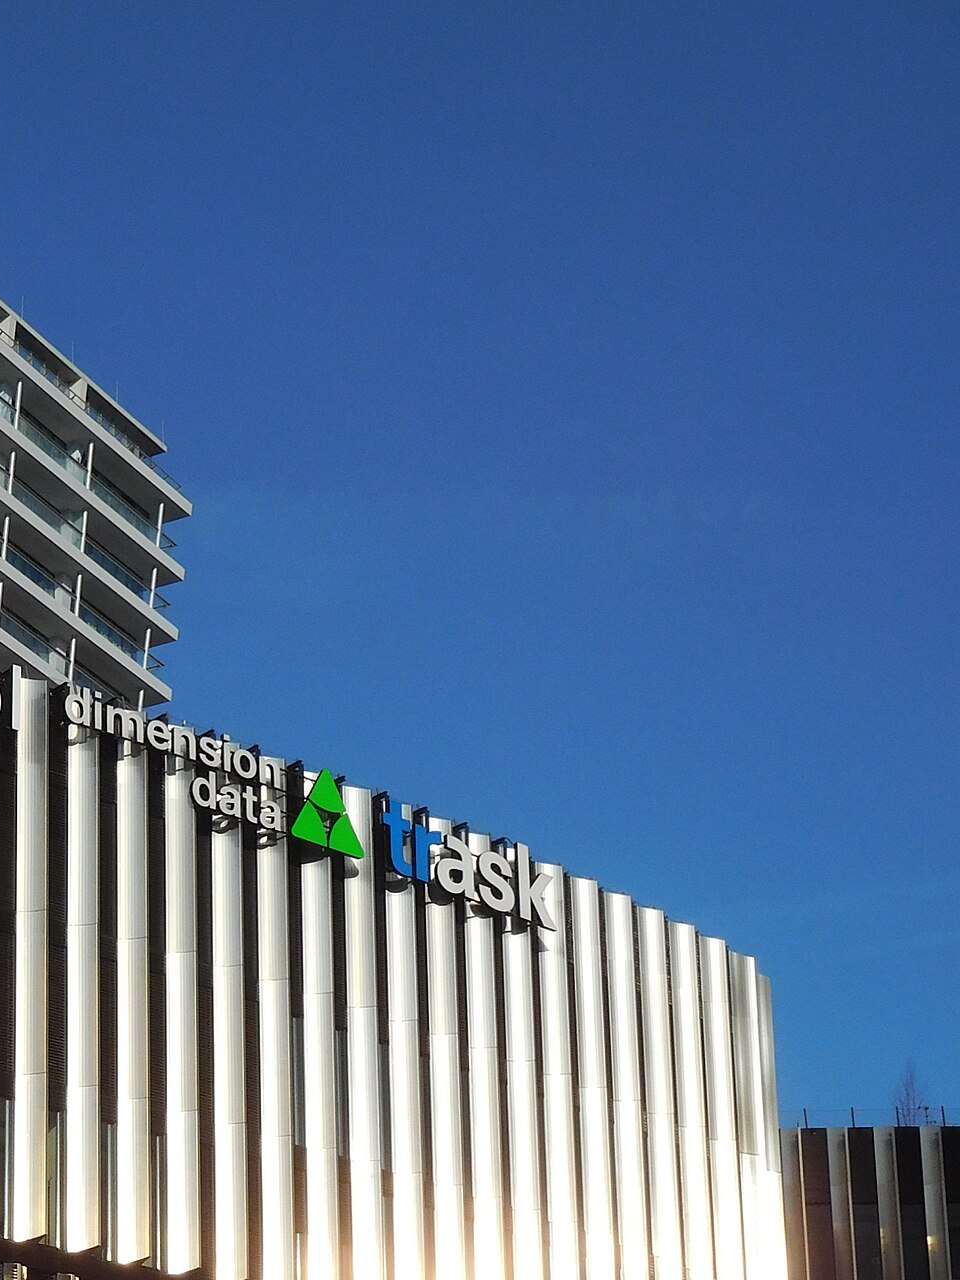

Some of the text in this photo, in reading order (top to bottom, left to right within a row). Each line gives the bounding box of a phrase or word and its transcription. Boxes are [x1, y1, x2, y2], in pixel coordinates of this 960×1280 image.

[65, 686, 281, 788] dimension
[192, 771, 282, 830] data
[383, 800, 557, 931] trask
